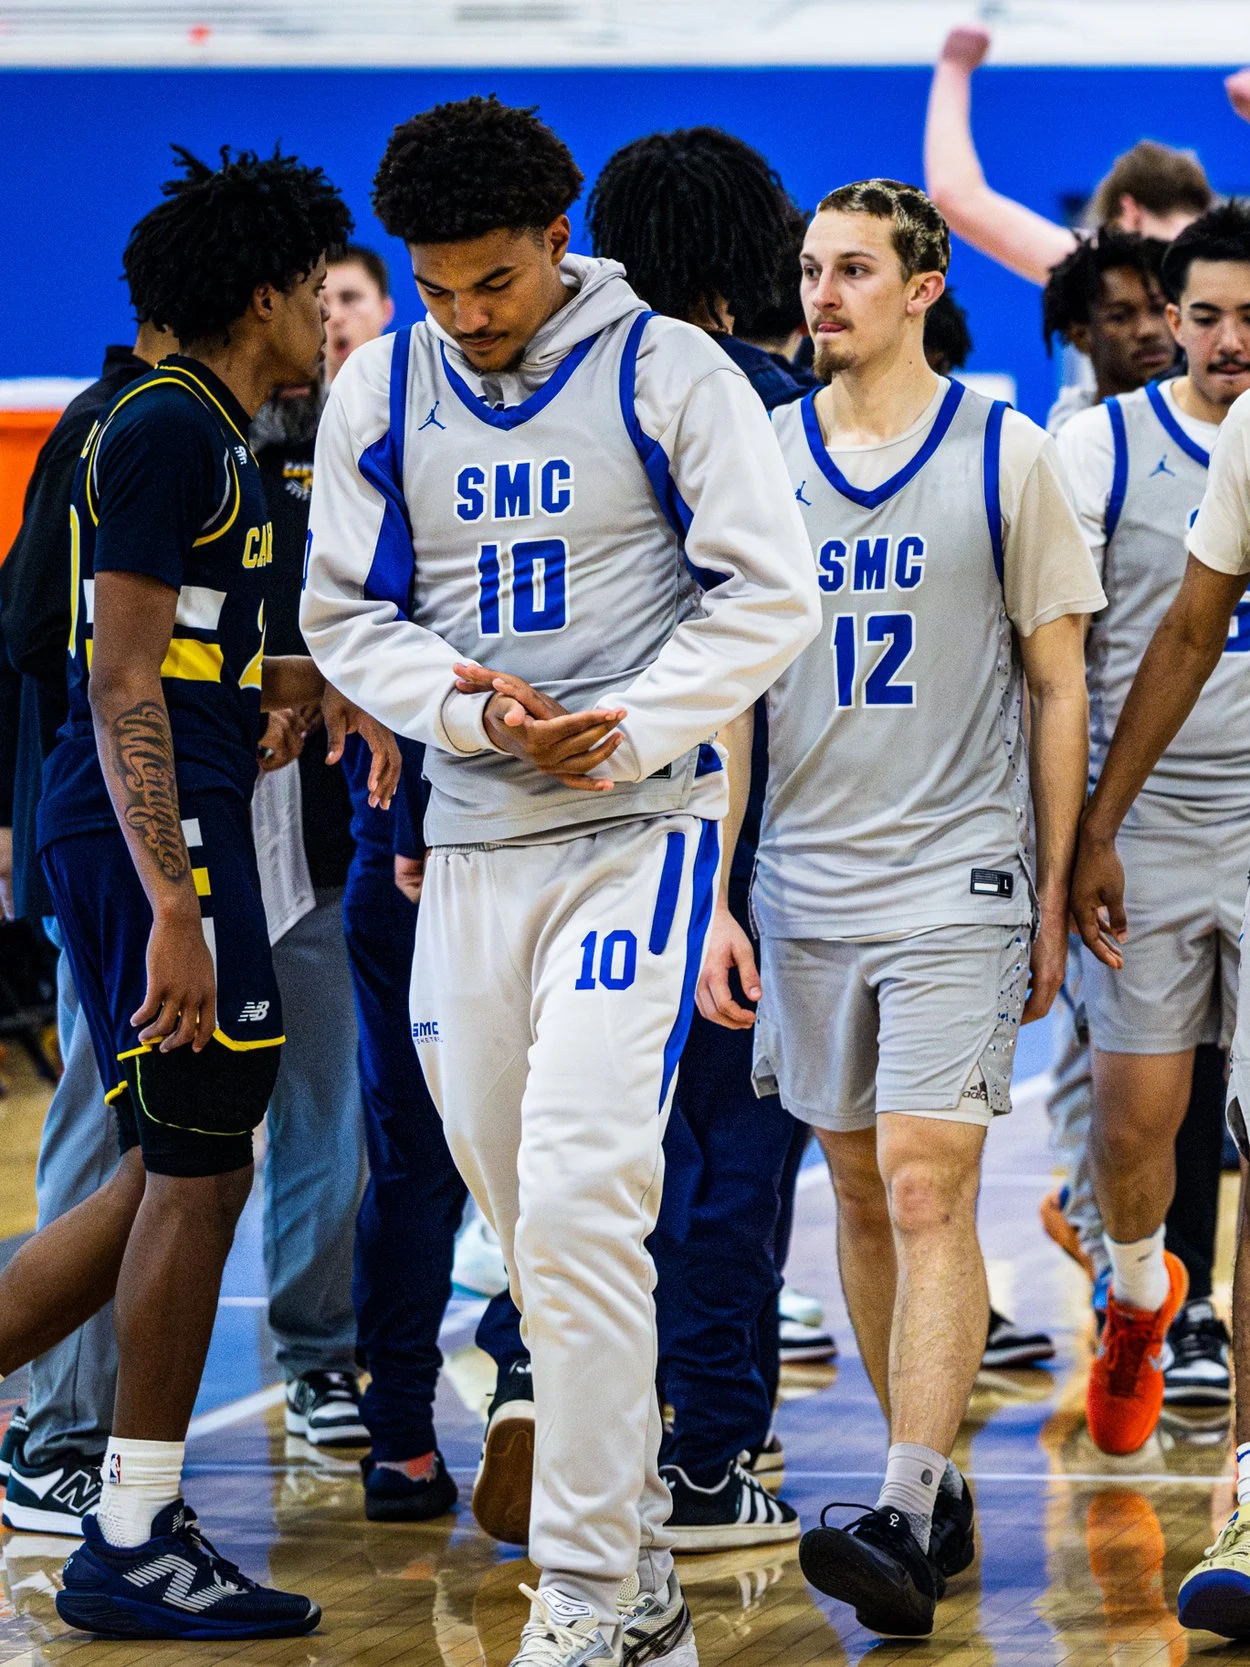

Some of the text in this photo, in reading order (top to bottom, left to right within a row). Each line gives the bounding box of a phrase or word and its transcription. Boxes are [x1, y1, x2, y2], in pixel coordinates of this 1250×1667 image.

[453, 456, 574, 524] SMC
[475, 535, 571, 639] 10
[816, 533, 927, 595] SMC
[830, 610, 917, 711] 12
[575, 930, 637, 990] 10
[412, 1021, 439, 1037] SMC
